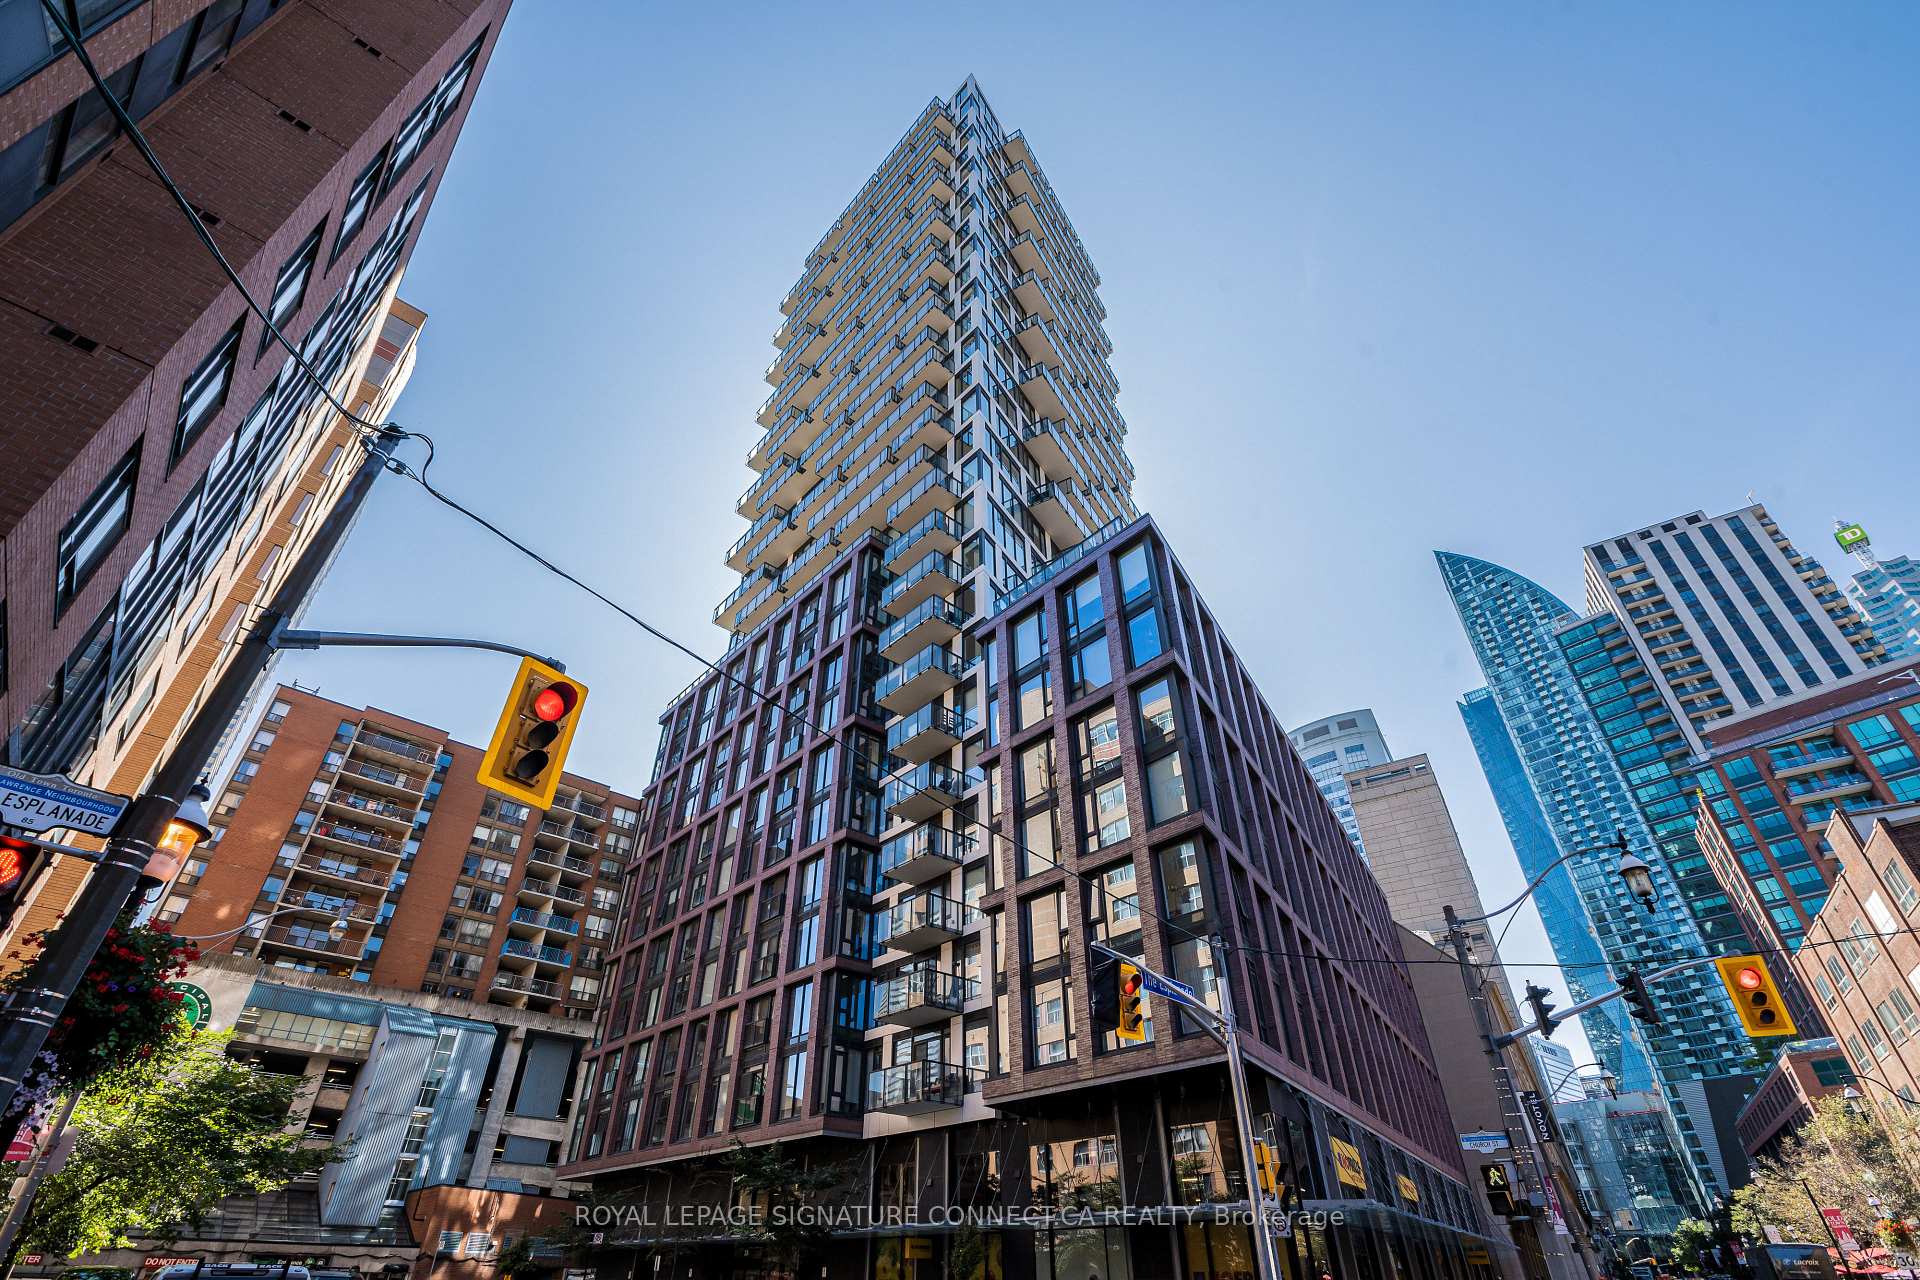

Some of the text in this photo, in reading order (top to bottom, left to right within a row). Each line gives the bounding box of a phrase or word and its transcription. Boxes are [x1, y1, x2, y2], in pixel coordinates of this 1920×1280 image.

[1838, 528, 1861, 541] TD
[0, 778, 42, 796] AWRENCE
[31, 775, 58, 790] Town
[63, 784, 99, 800] Toronto
[1, 792, 111, 831] ESPLANADE
[180, 984, 209, 1019] CIPAL
[1529, 1092, 1551, 1141] NOVOTEL
[145, 1258, 159, 1266] DO
[159, 1258, 176, 1266] NOT
[1897, 1256, 1915, 1267] 30
